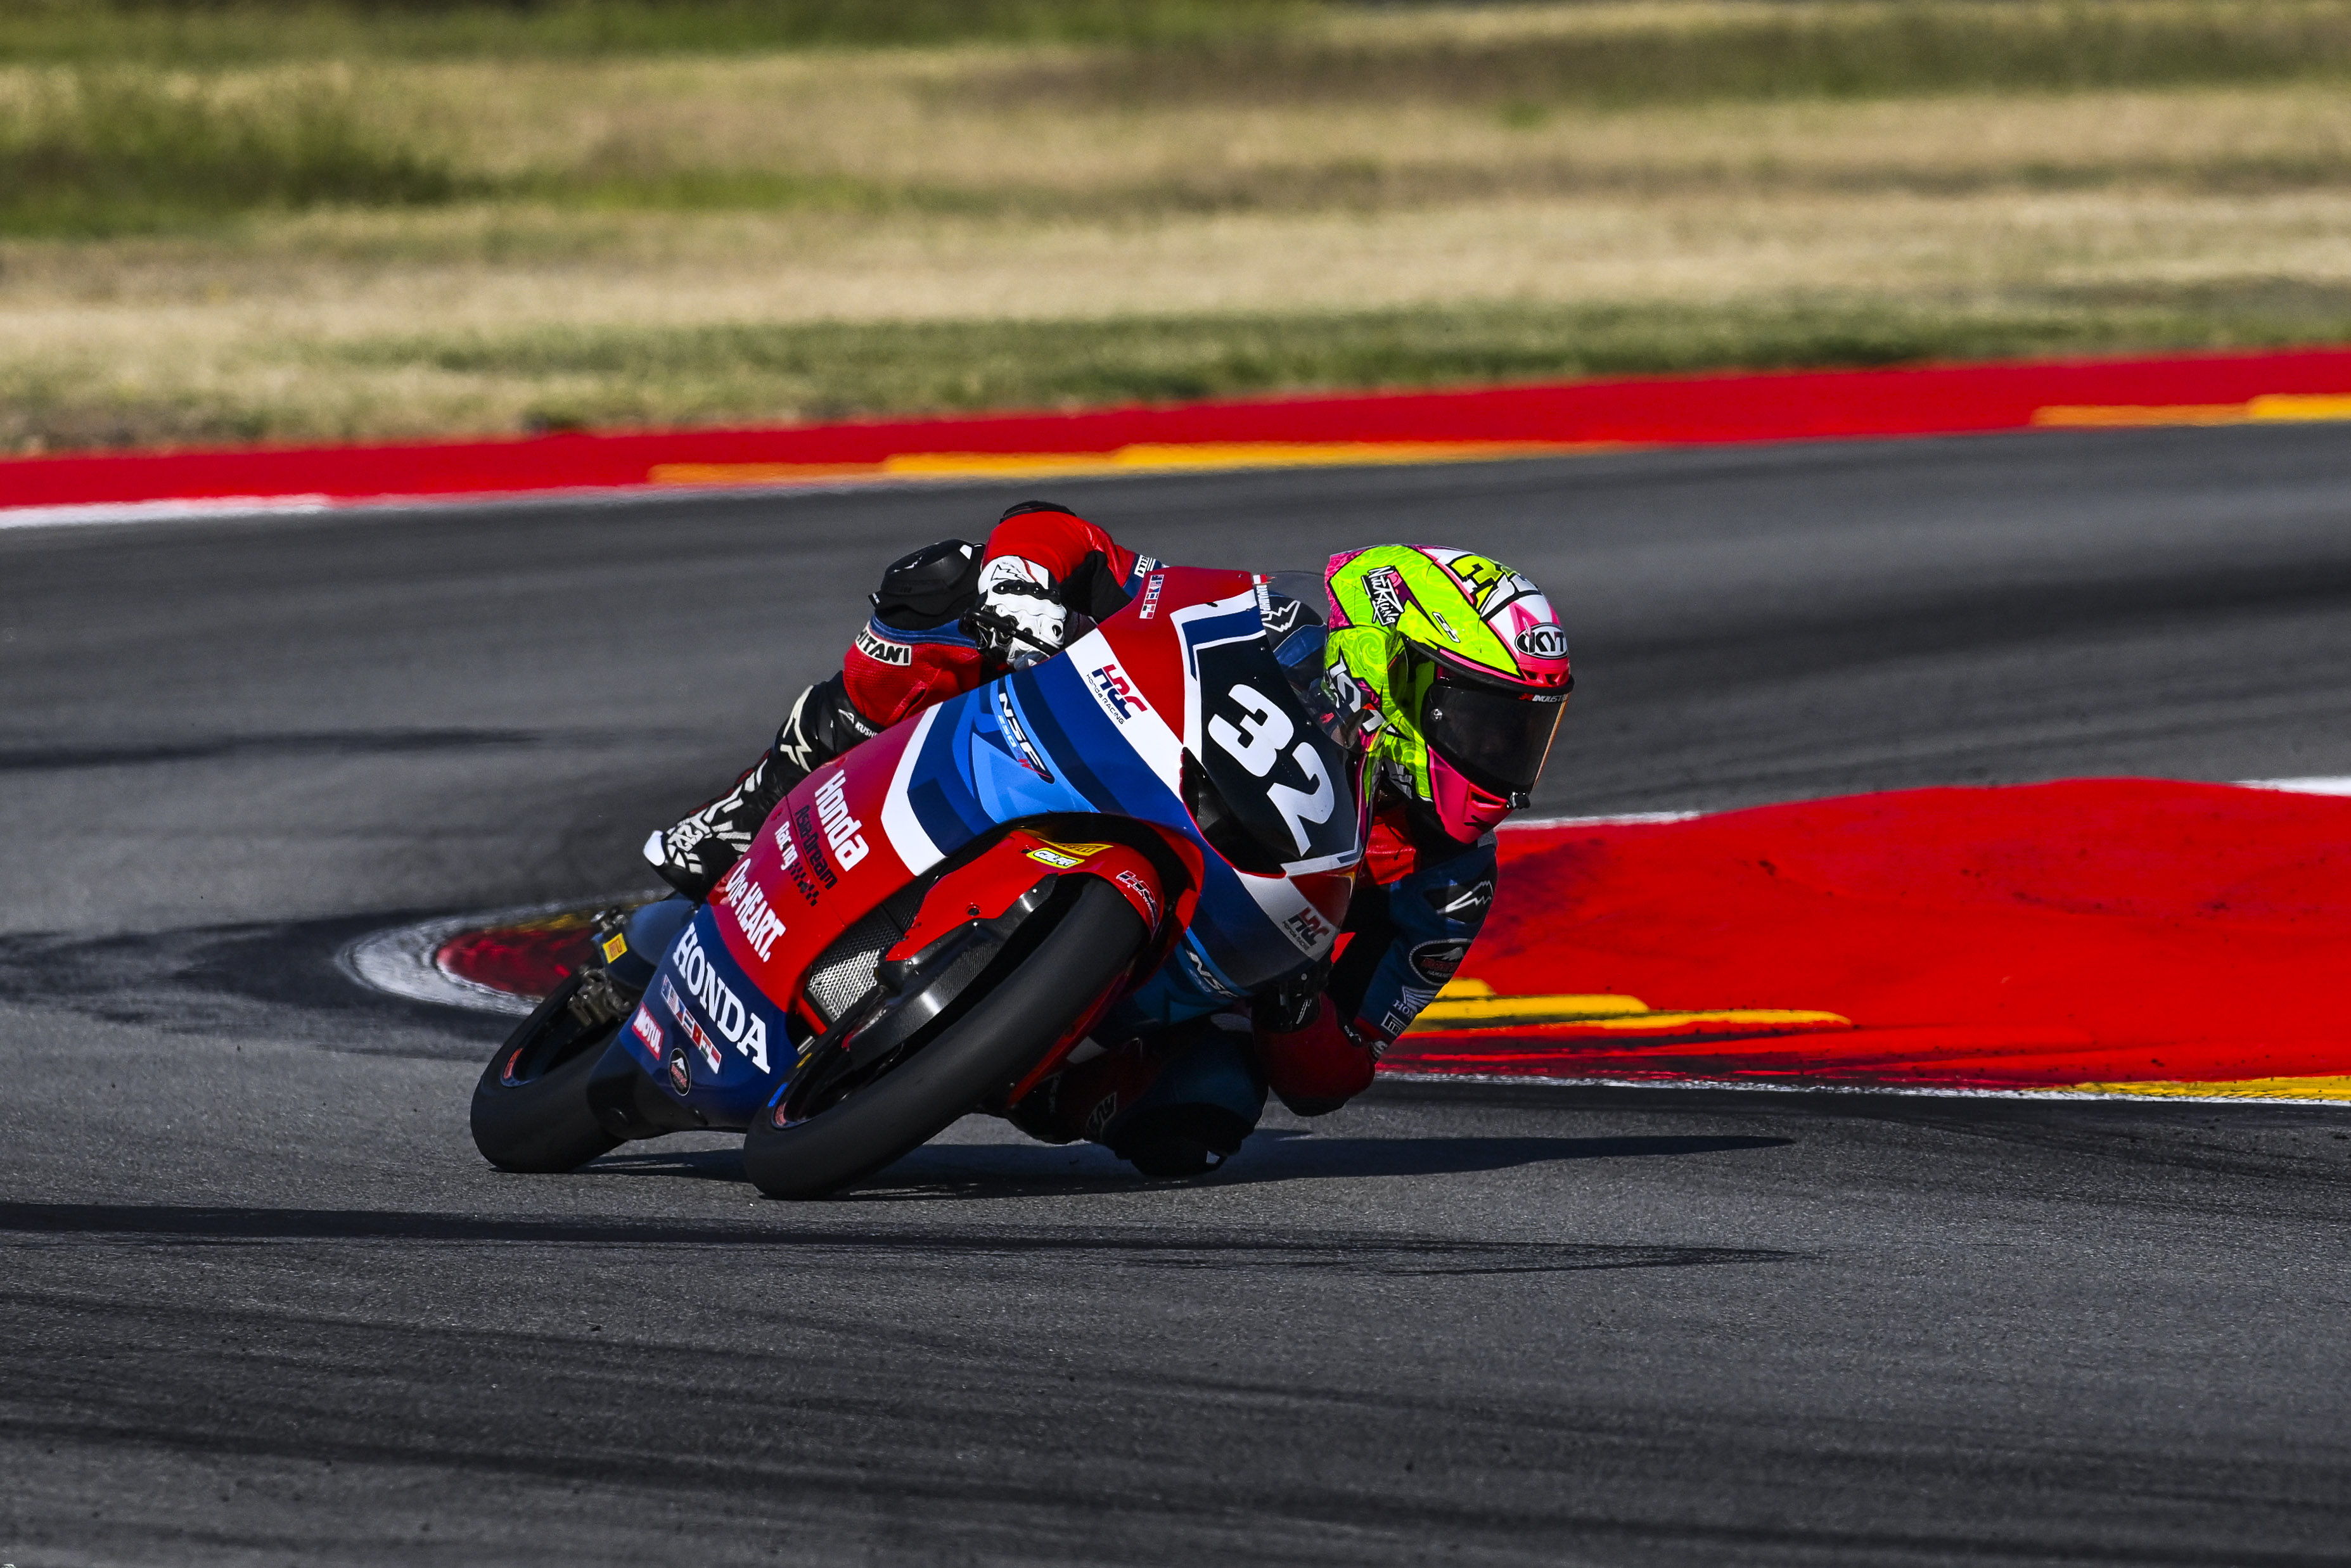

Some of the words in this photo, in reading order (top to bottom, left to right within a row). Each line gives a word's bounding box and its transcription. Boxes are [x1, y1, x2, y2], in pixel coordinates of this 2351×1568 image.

[1526, 630, 1565, 654] KYT
[1091, 664, 1148, 720] HRC
[1102, 698, 1125, 725] RACING
[999, 692, 1046, 772] NSF
[1207, 684, 1335, 857] 32
[774, 820, 798, 871] Racng
[814, 769, 869, 872] Honda
[725, 858, 752, 908] One
[734, 881, 786, 962] HEART.
[1288, 907, 1330, 947] HRC
[673, 922, 771, 1074] HONDA
[634, 1007, 662, 1054] MOTUL
